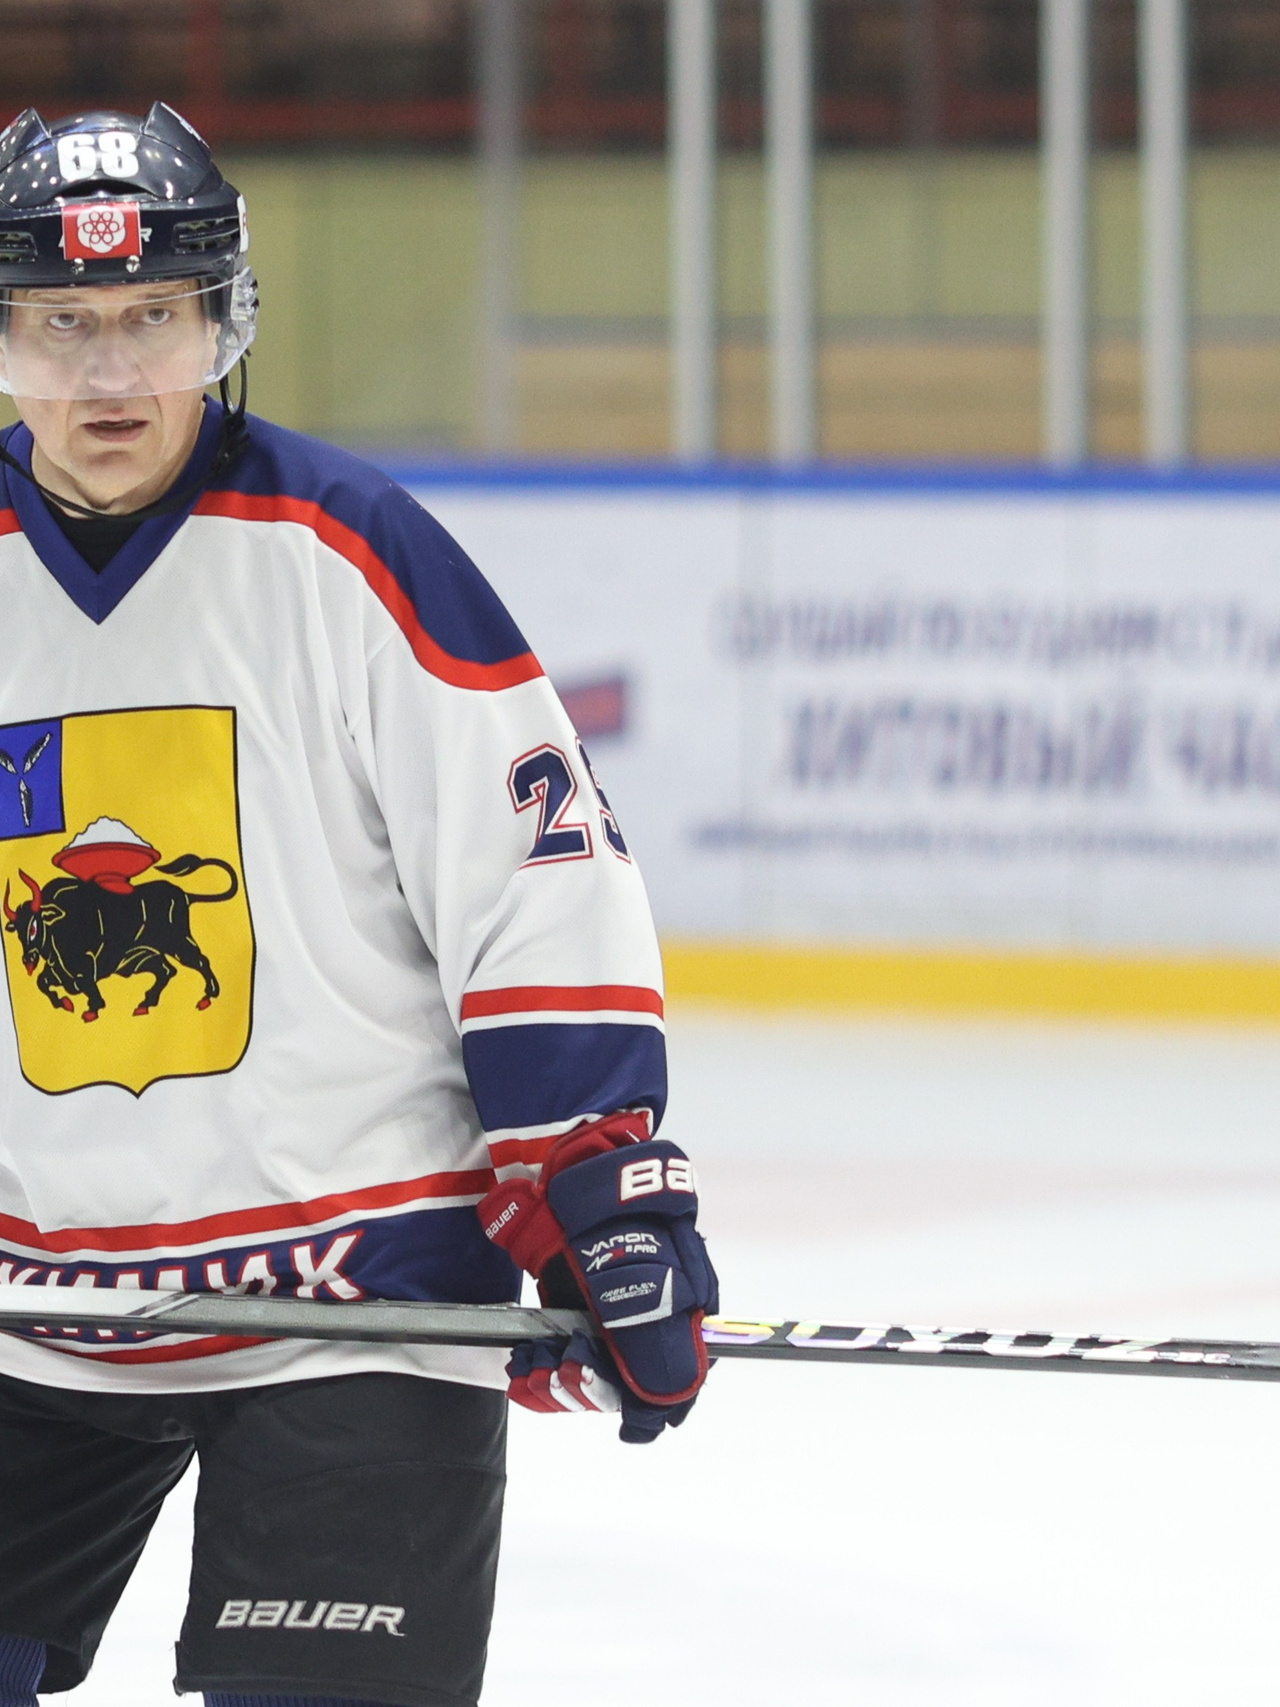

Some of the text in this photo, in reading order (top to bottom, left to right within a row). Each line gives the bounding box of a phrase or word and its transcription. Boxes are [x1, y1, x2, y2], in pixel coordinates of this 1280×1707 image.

[57, 131, 139, 181] 68
[484, 1200, 520, 1240] BAUER
[580, 1232, 662, 1257] VAPOR
[215, 1599, 407, 1637] BAUER
